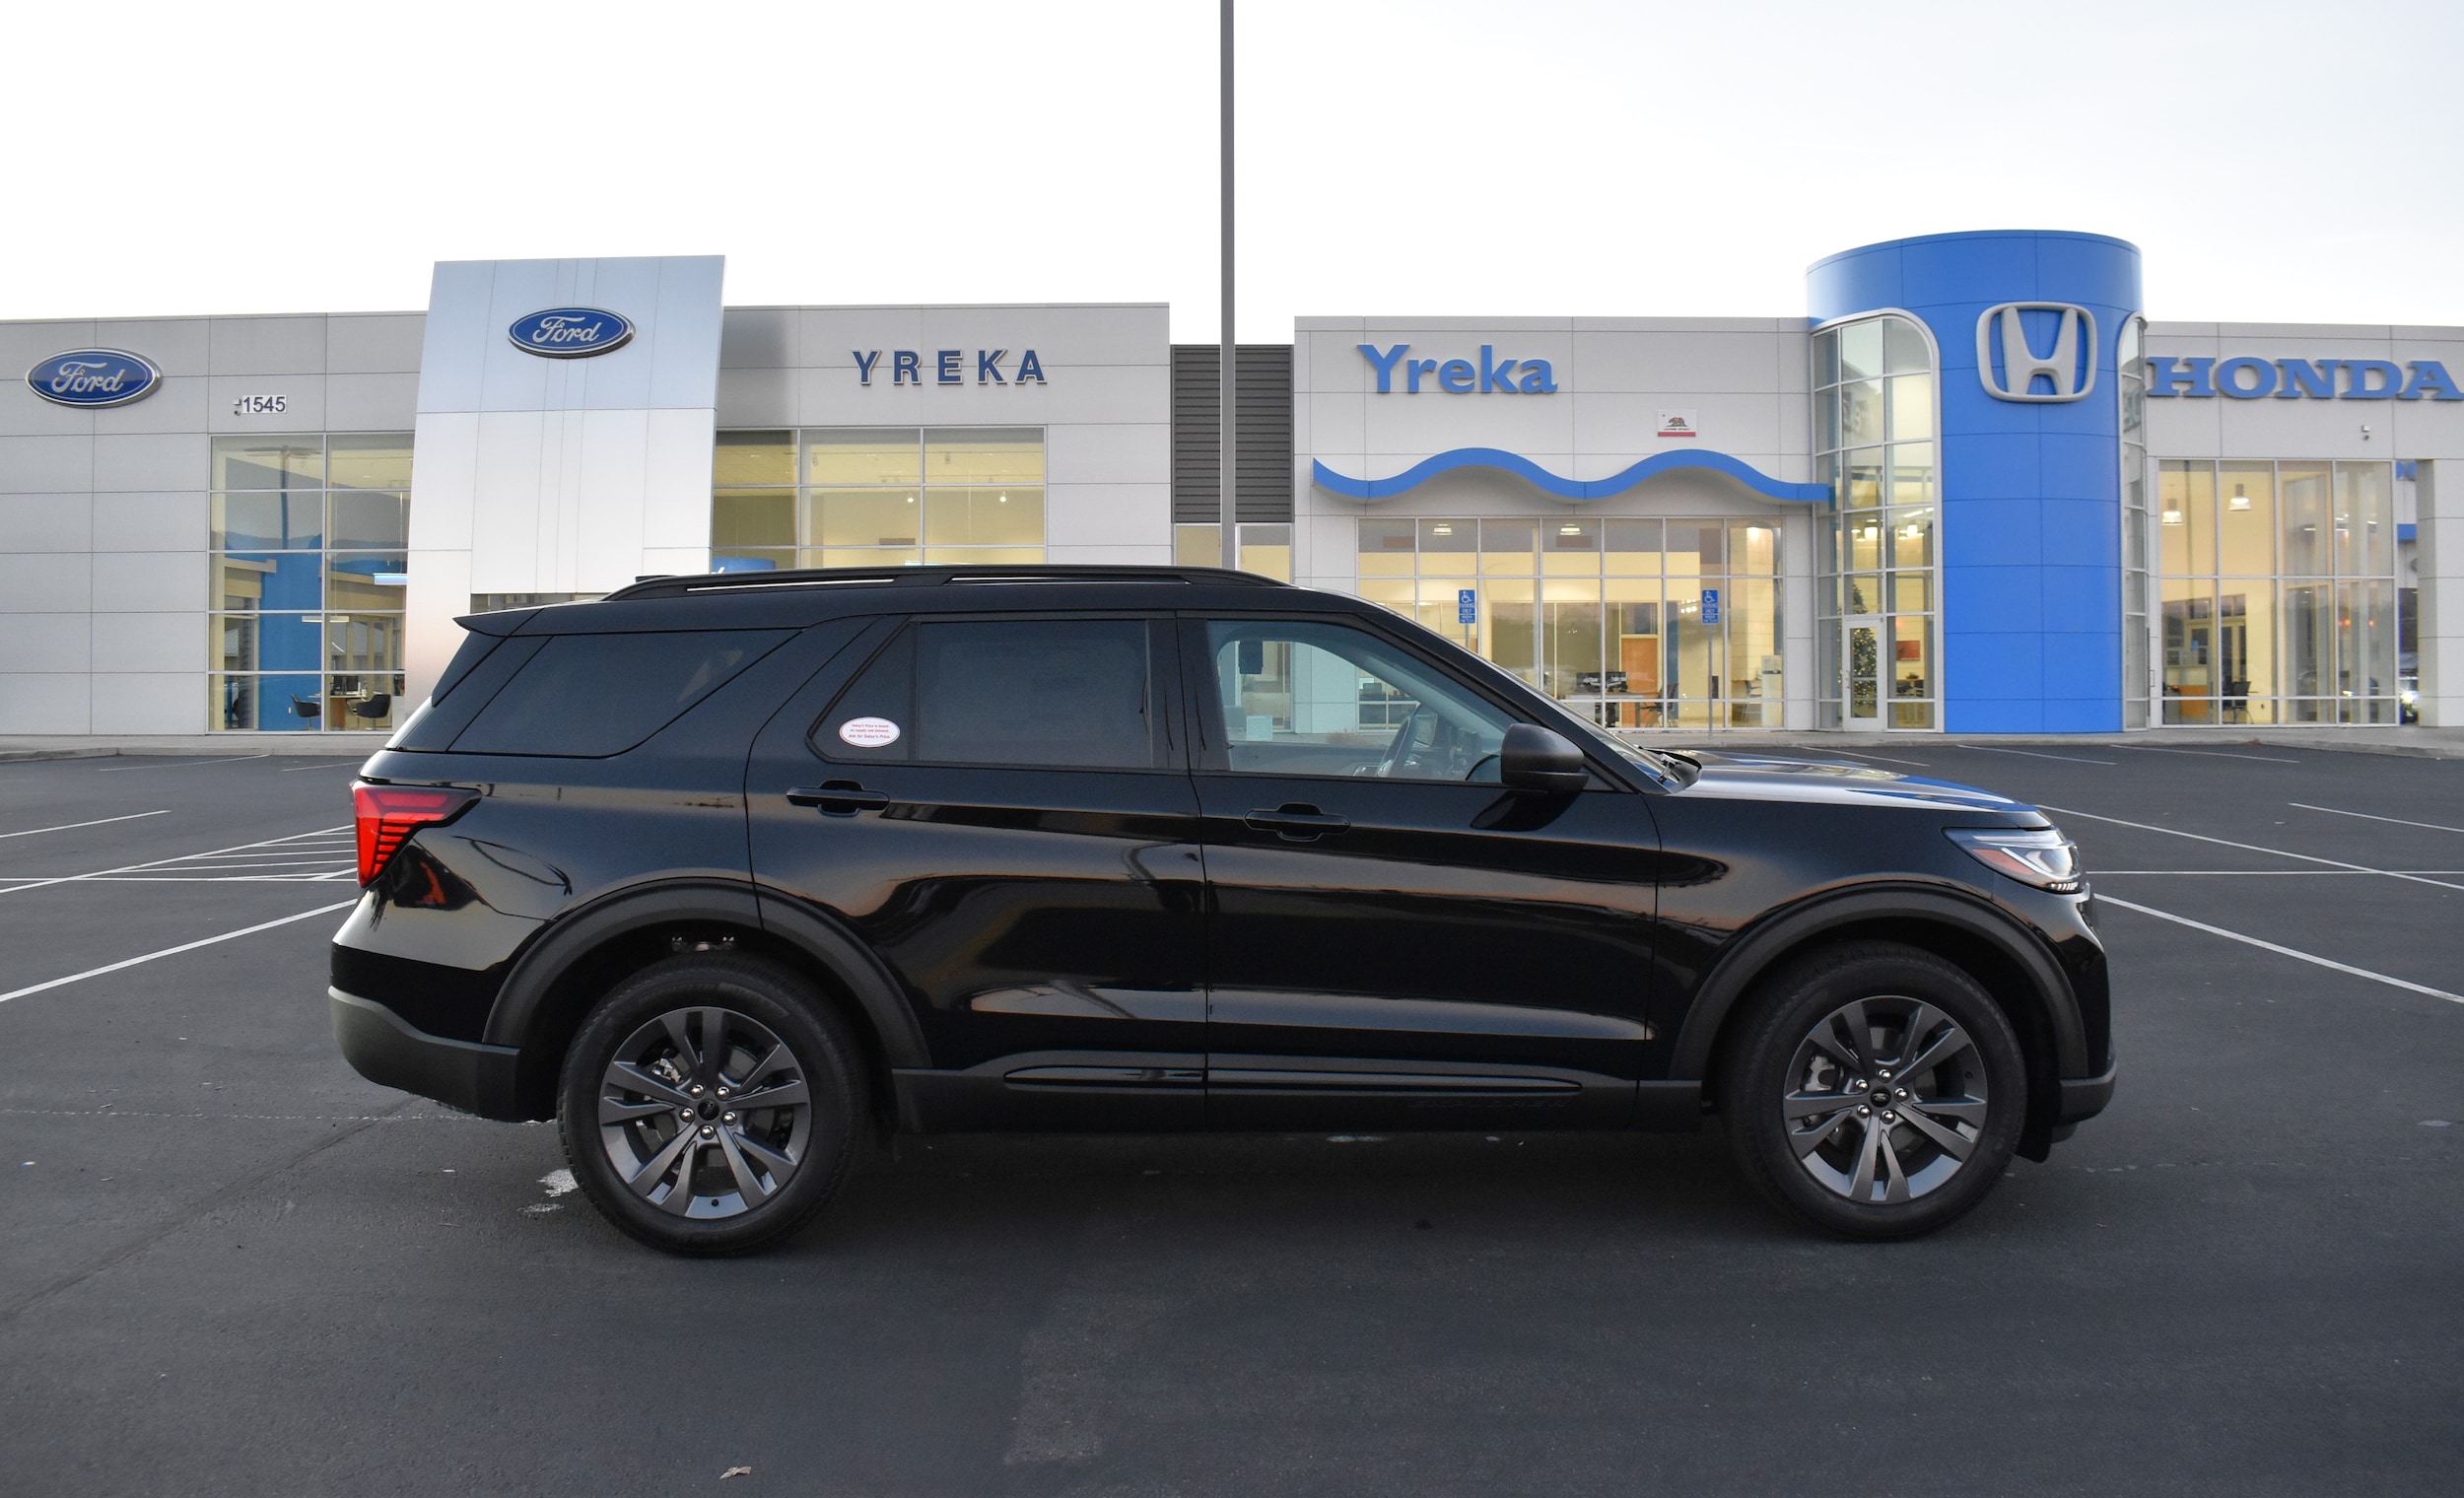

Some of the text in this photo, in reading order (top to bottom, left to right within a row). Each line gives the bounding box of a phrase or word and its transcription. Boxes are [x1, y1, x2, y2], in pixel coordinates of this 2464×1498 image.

[532, 315, 602, 343] Ford
[51, 361, 126, 393] Ford
[853, 349, 1046, 383] YREKA
[1356, 344, 1558, 393] Yreka
[2145, 356, 2464, 400] HONDA
[243, 396, 286, 413] 1545
